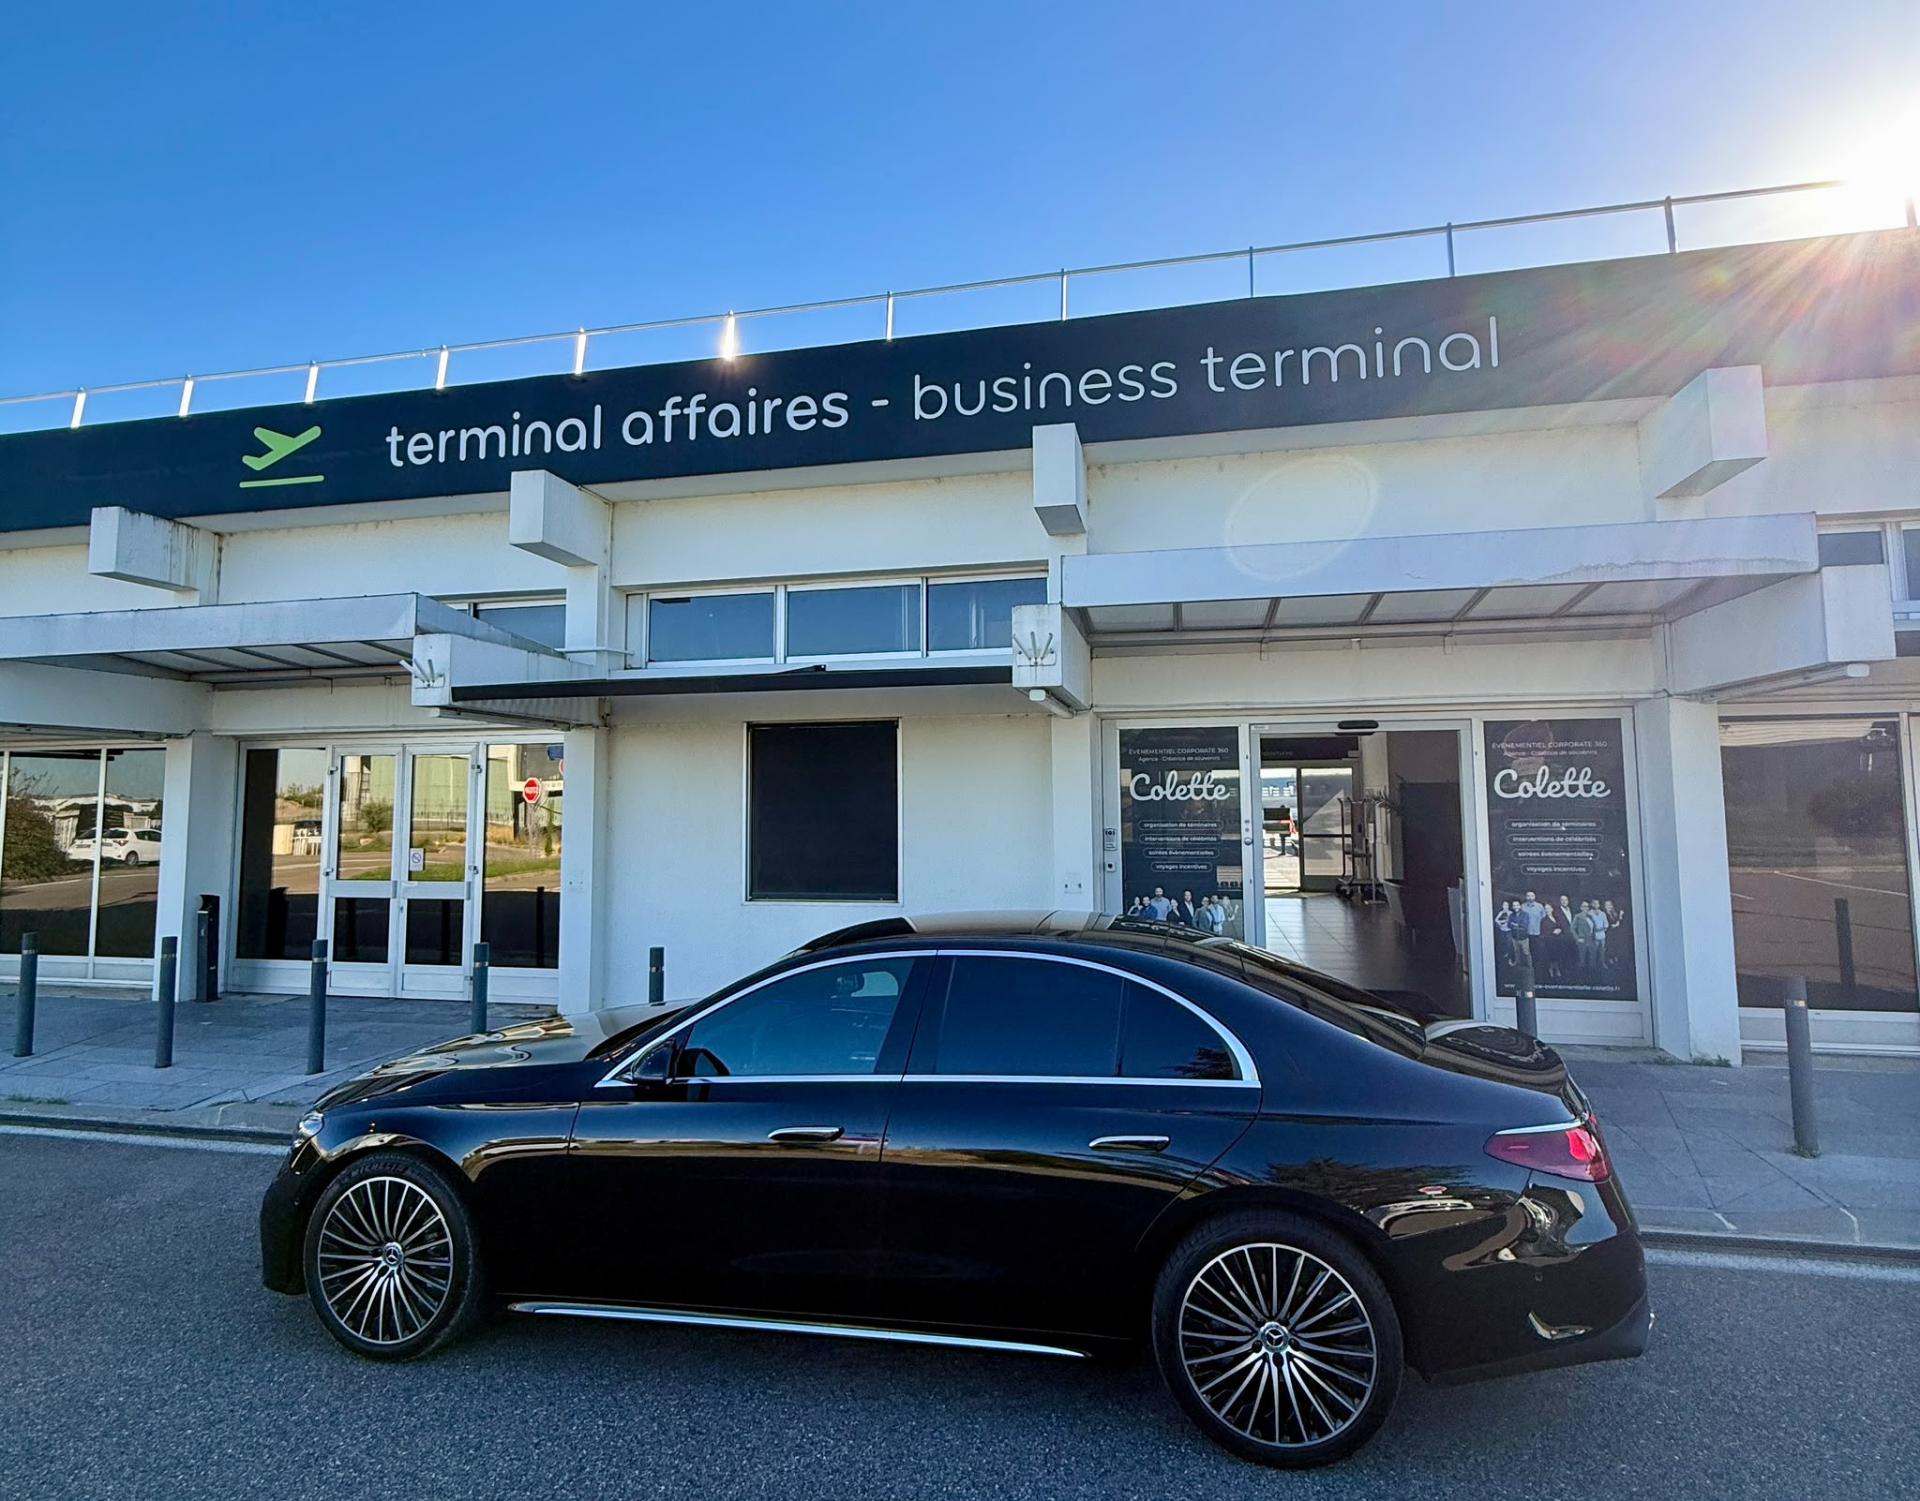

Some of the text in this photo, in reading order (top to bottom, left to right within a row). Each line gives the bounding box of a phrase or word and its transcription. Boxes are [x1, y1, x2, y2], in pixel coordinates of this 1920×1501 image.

[385, 405, 602, 468] terminal
[621, 387, 849, 447] affaires
[914, 361, 1178, 420] business
[1200, 315, 1499, 392] terminal
[1129, 770, 1231, 801] Colette
[1493, 764, 1612, 799] Colette
